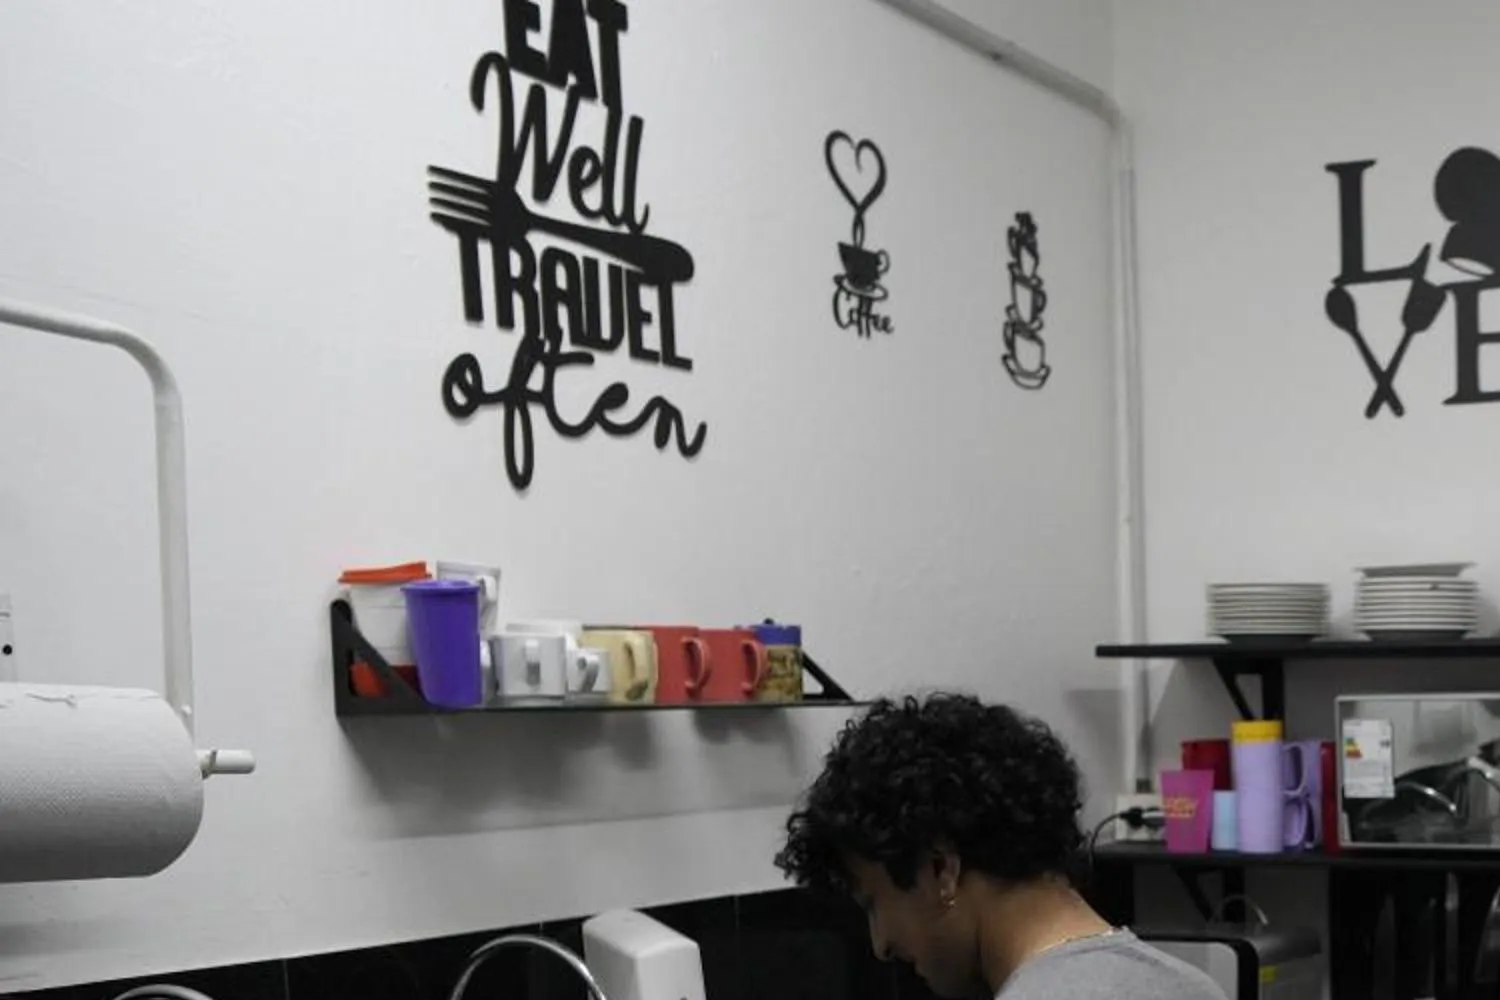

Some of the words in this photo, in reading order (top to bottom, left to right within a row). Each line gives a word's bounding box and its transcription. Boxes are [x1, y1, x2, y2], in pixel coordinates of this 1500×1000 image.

[503, 0, 628, 106] EAT
[471, 52, 649, 235] Well
[453, 222, 693, 371] TRAVEL
[442, 325, 707, 489] often
